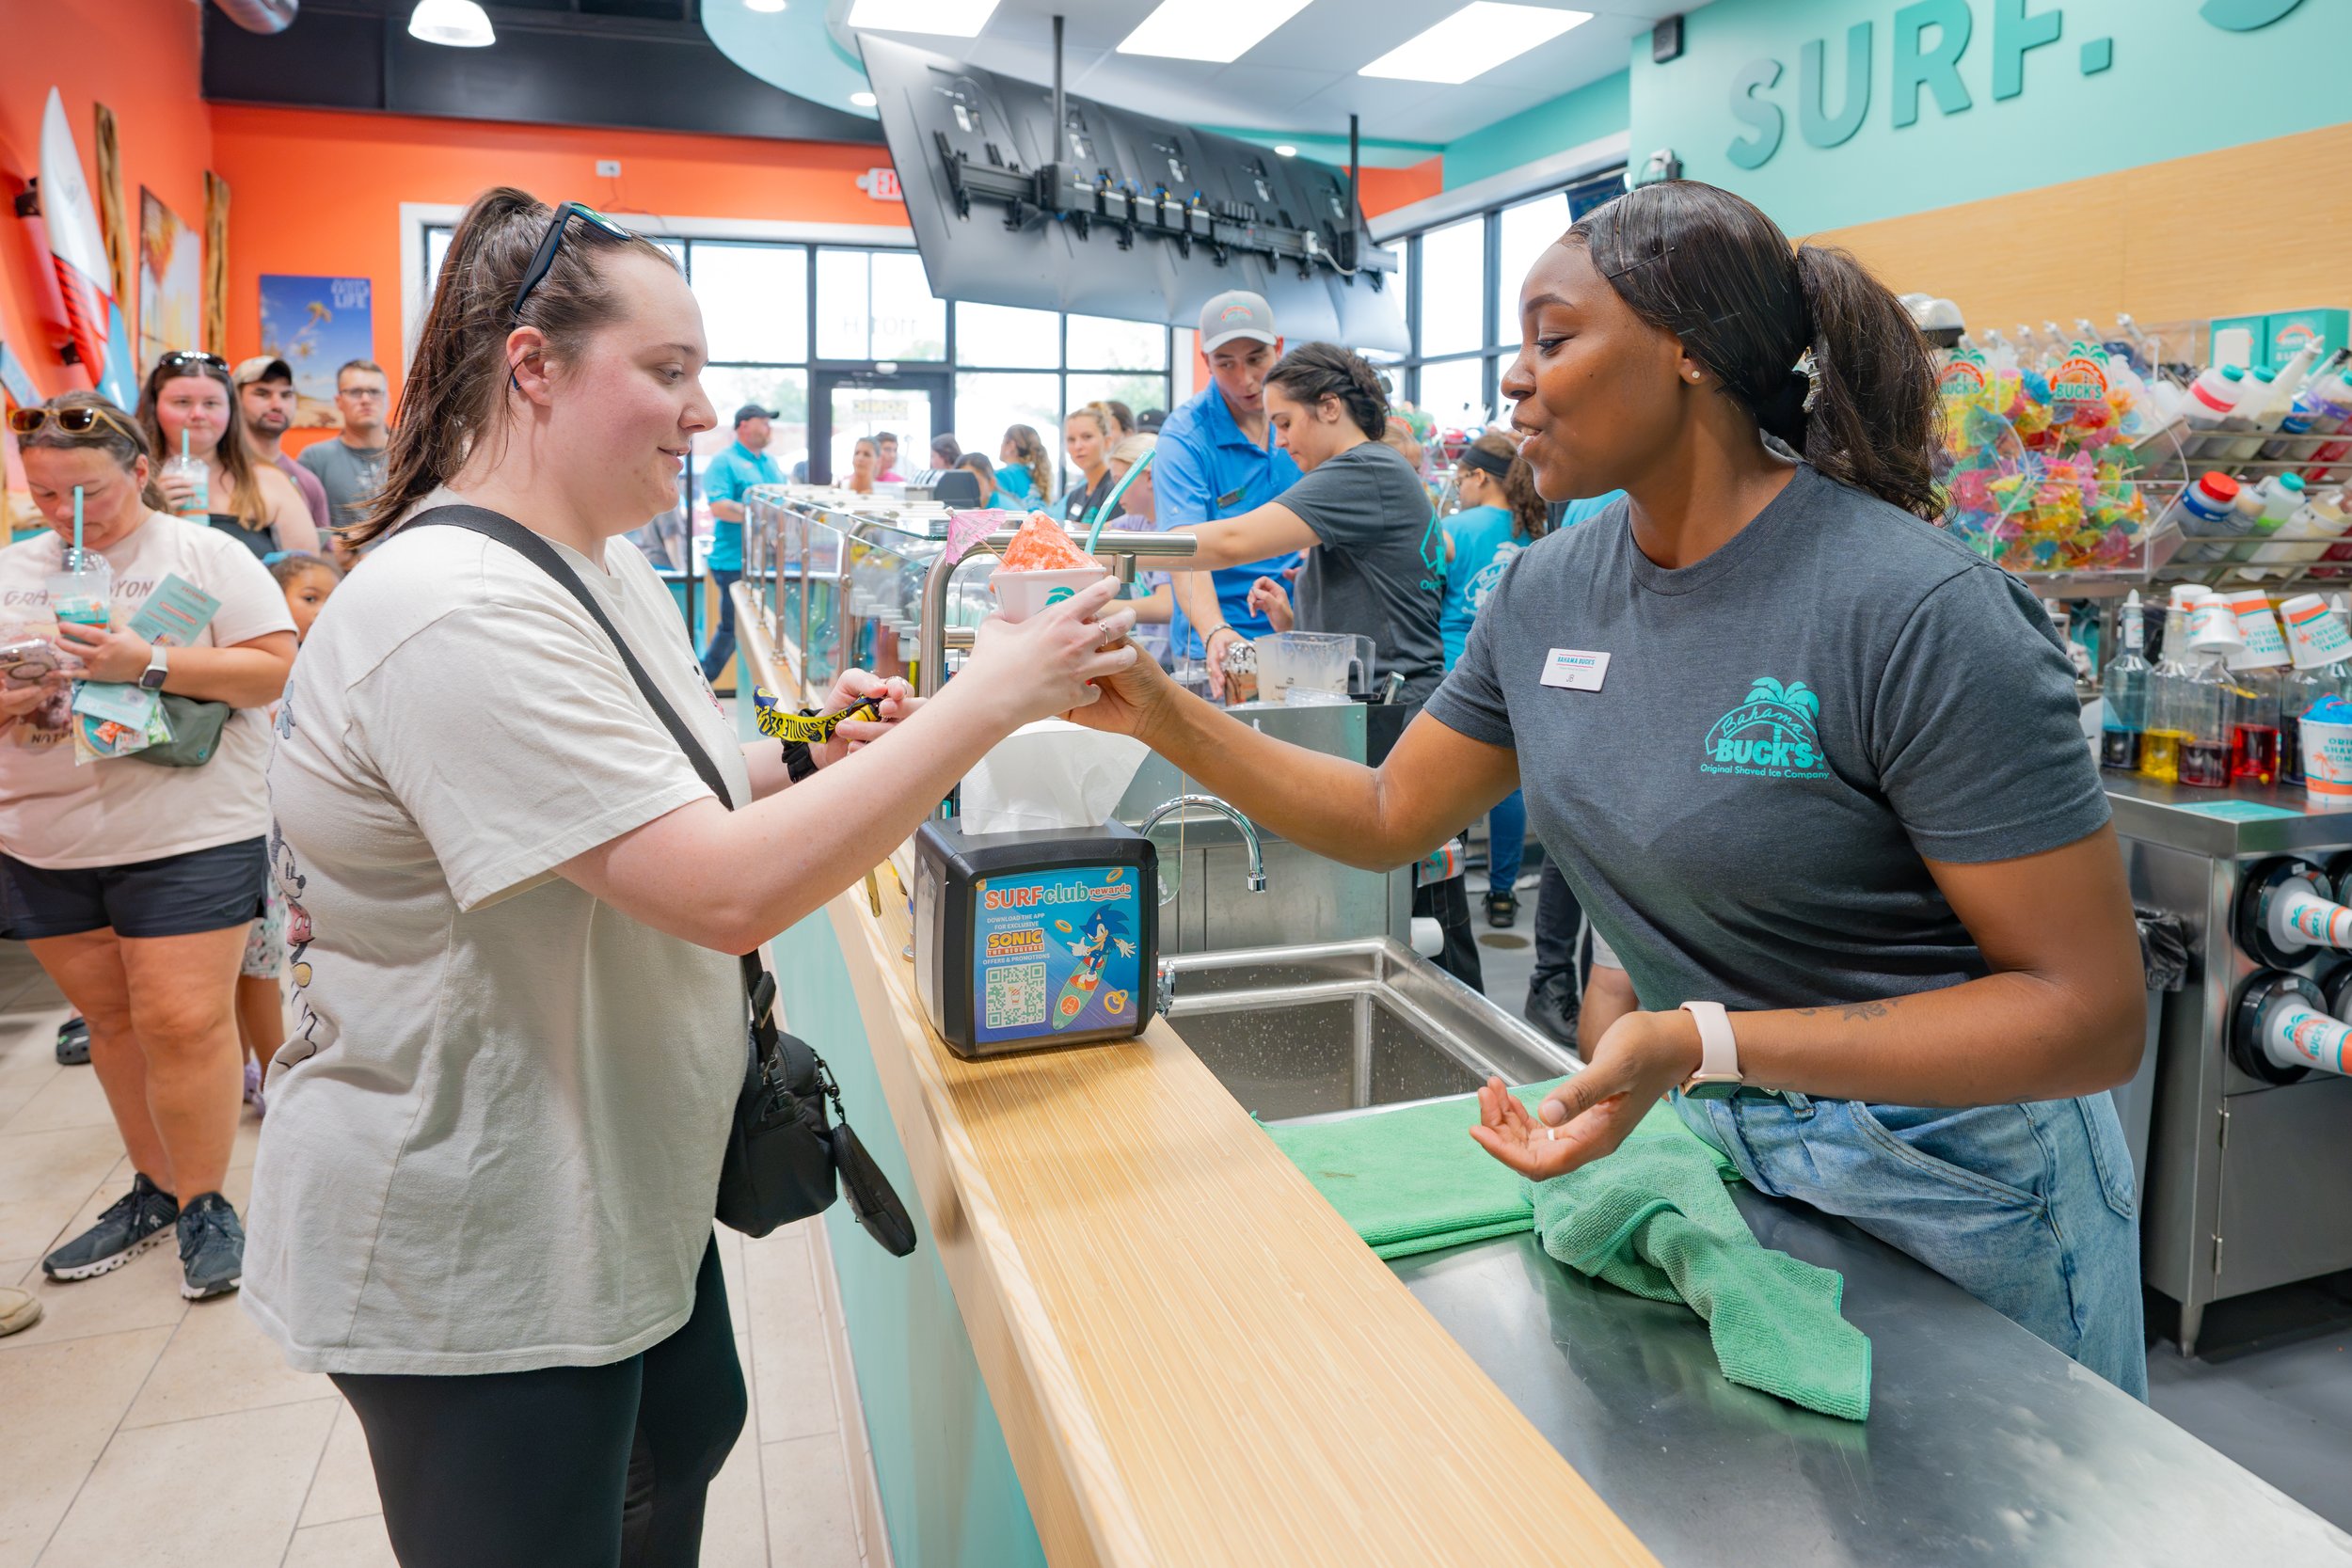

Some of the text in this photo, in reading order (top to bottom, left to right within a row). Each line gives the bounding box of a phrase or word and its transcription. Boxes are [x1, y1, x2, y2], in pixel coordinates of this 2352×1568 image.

[1725, 0, 2113, 171] SURF.
[2057, 383, 2103, 400] BUCK'S
[1721, 705, 1812, 744] Bahama
[1715, 737, 1816, 768] BUCK'S
[1700, 764, 1830, 780] Original Shaved Ice Company
[1089, 882, 1132, 896] rewards
[987, 915, 1021, 924] DOWNLOAD
[1007, 921, 1040, 929] EXCLUSIVE
[988, 929, 1043, 949] SONIC
[1004, 944, 1043, 954] HEDGEHOG
[982, 957, 1006, 965] OFFERS
[1011, 953, 1051, 962] PROMOTIONS
